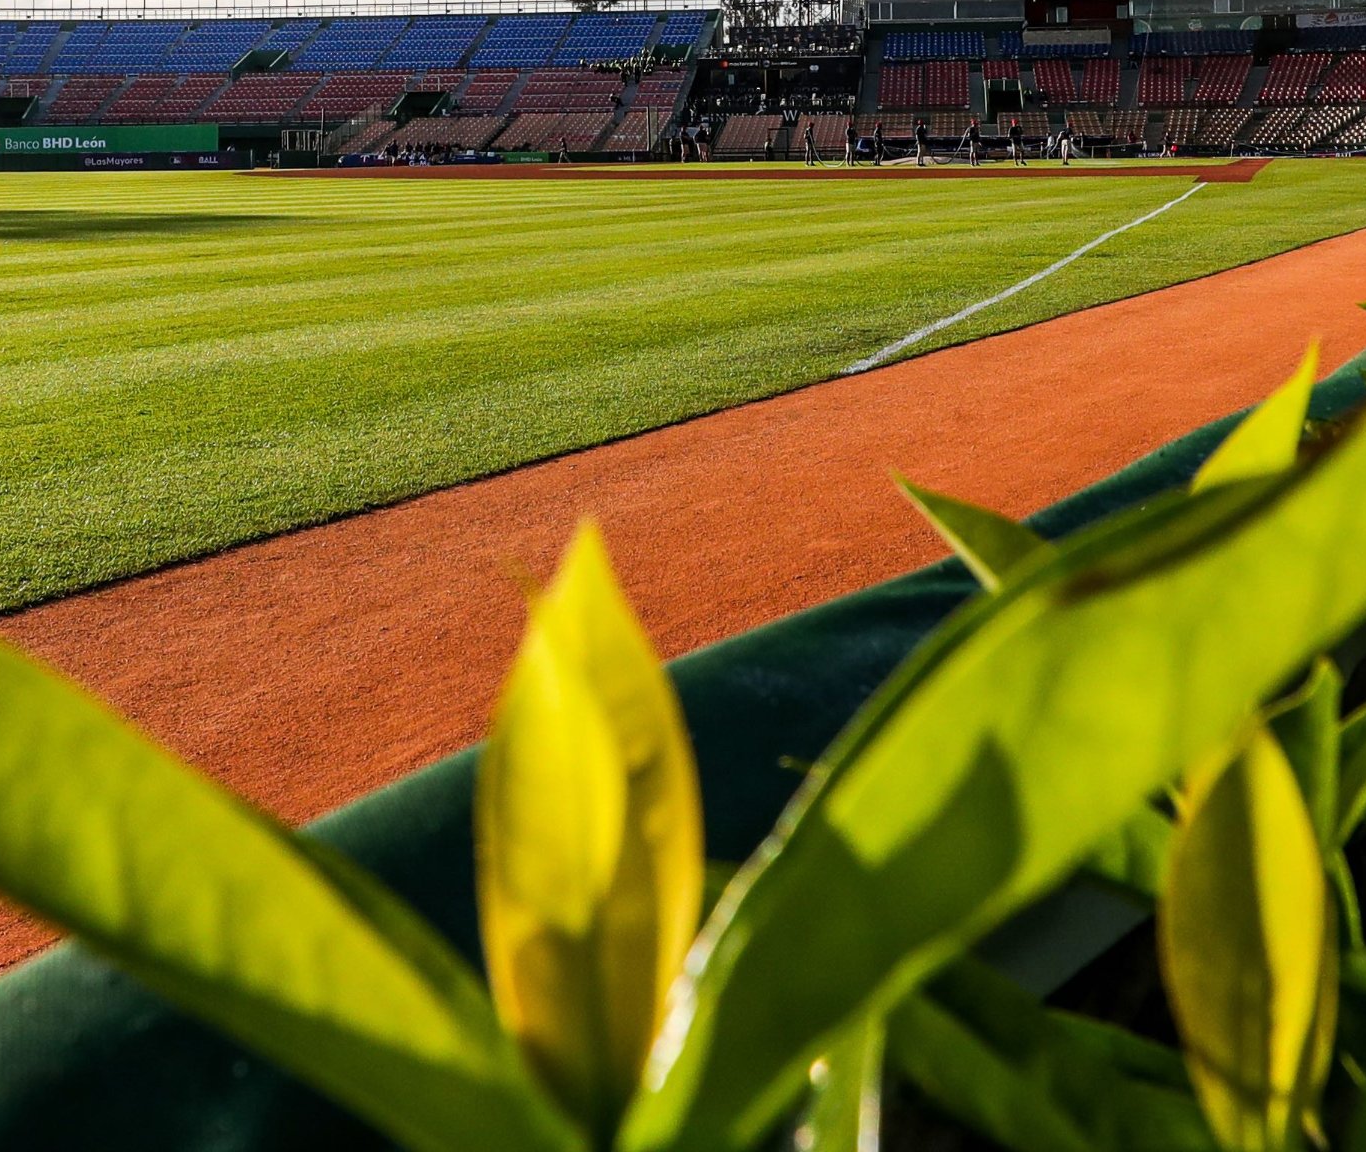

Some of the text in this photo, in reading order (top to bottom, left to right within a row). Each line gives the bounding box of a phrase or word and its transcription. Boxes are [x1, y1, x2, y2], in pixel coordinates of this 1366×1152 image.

[5, 135, 106, 149] Banco BHD León
[84, 156, 144, 166] @LasMayores
